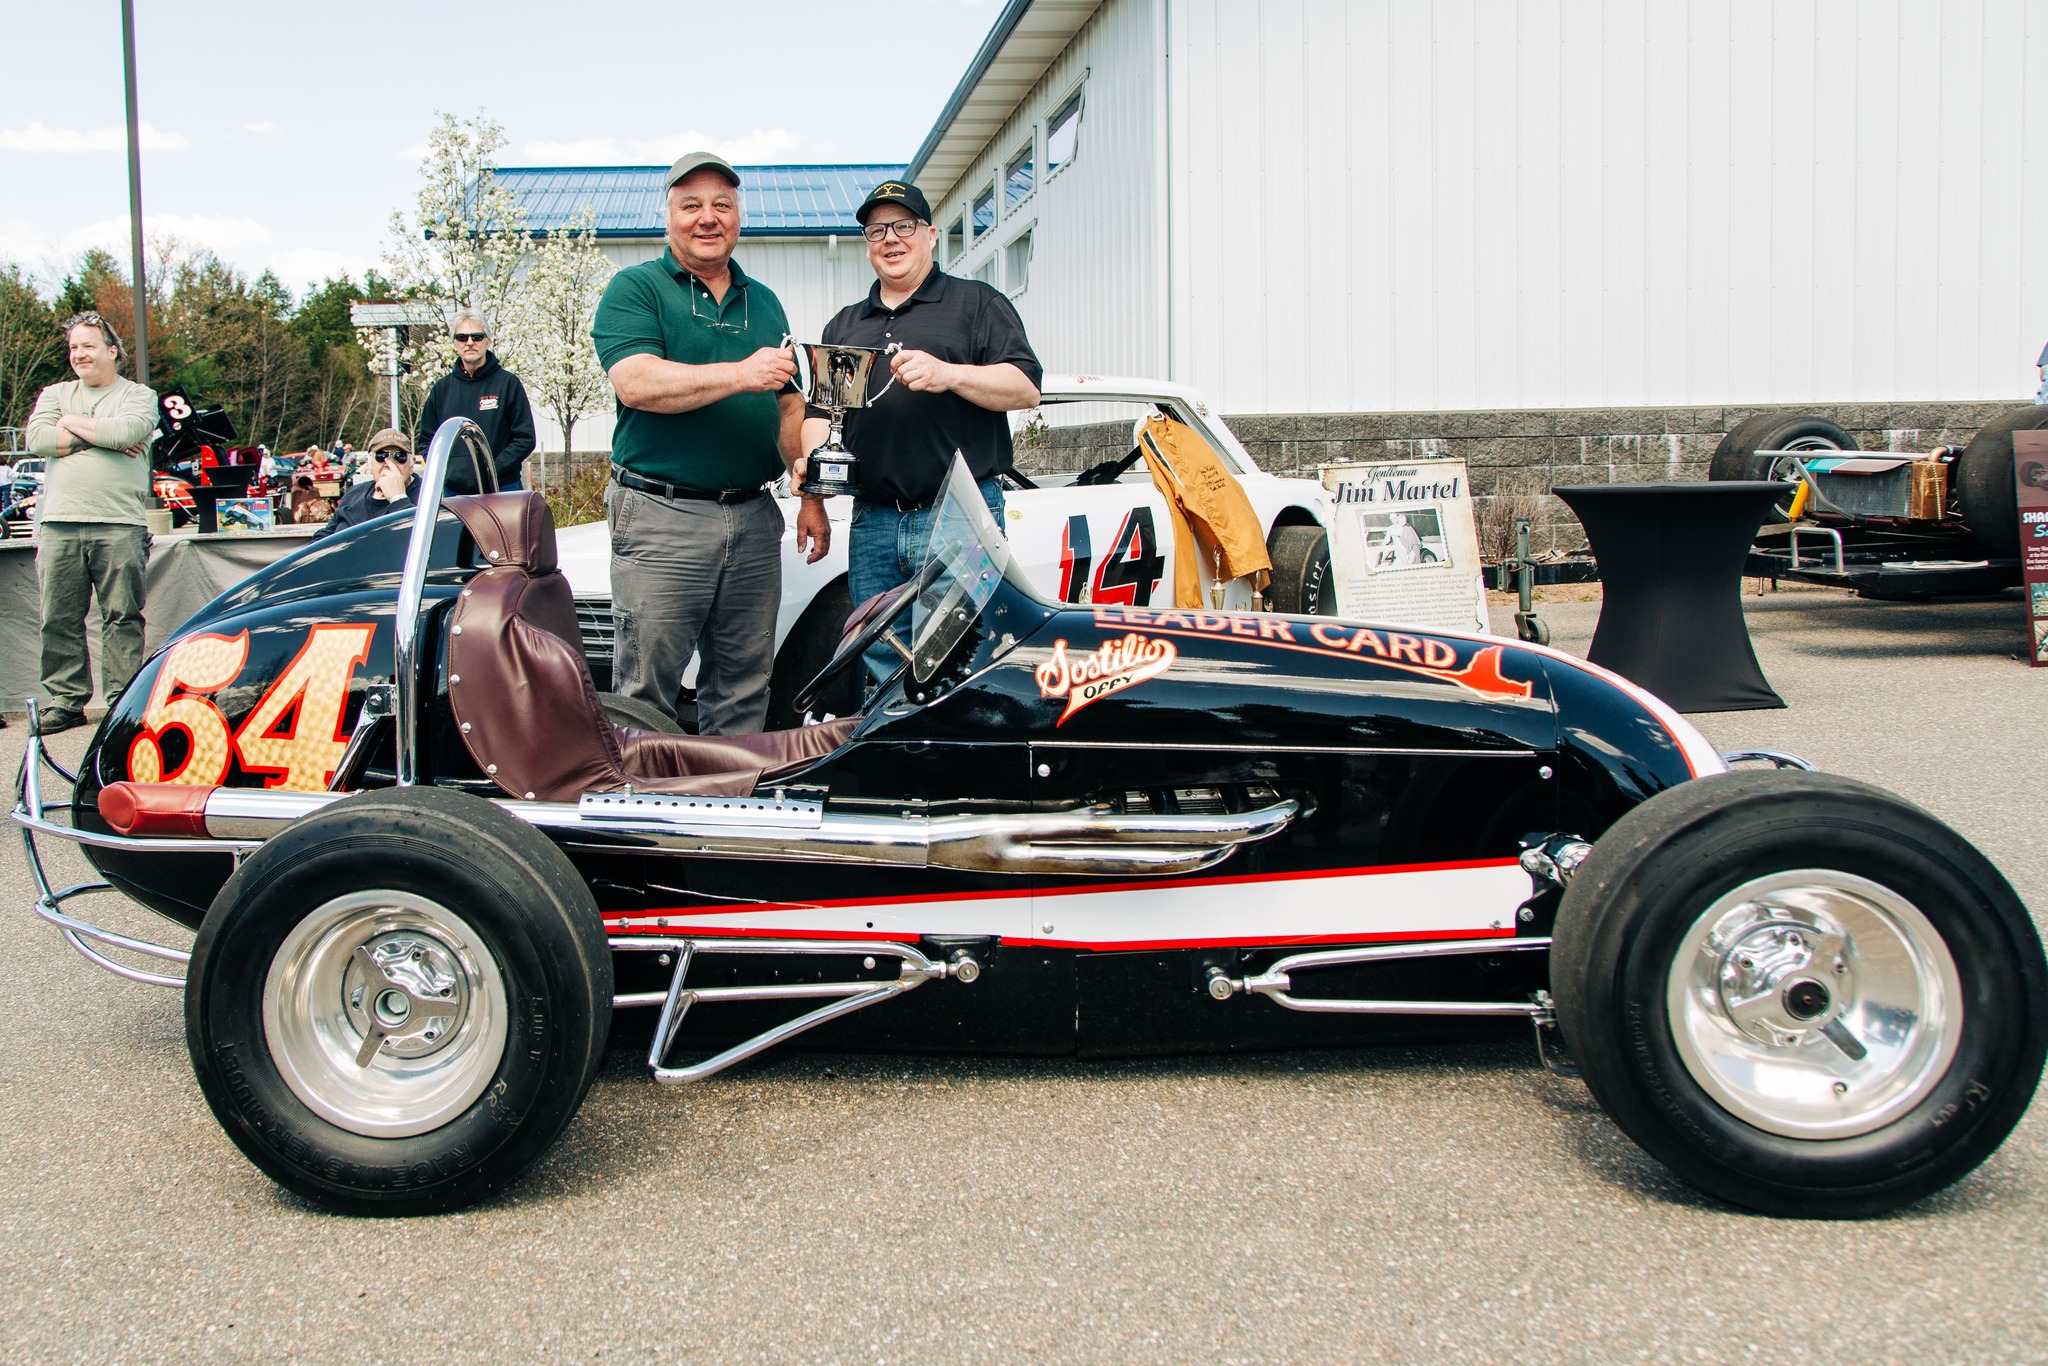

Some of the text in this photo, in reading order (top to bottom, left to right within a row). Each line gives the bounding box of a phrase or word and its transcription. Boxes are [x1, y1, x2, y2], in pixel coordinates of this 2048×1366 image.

[163, 395, 192, 420] 3
[1331, 477, 1460, 505] Jim Martel
[1362, 466, 1418, 486] Gentleman
[1058, 506, 1165, 607] 14
[1093, 606, 1457, 669] LEADER CARD
[1034, 632, 1177, 698] Sostilio
[1083, 673, 1134, 699] OFFY
[127, 623, 377, 791] 54
